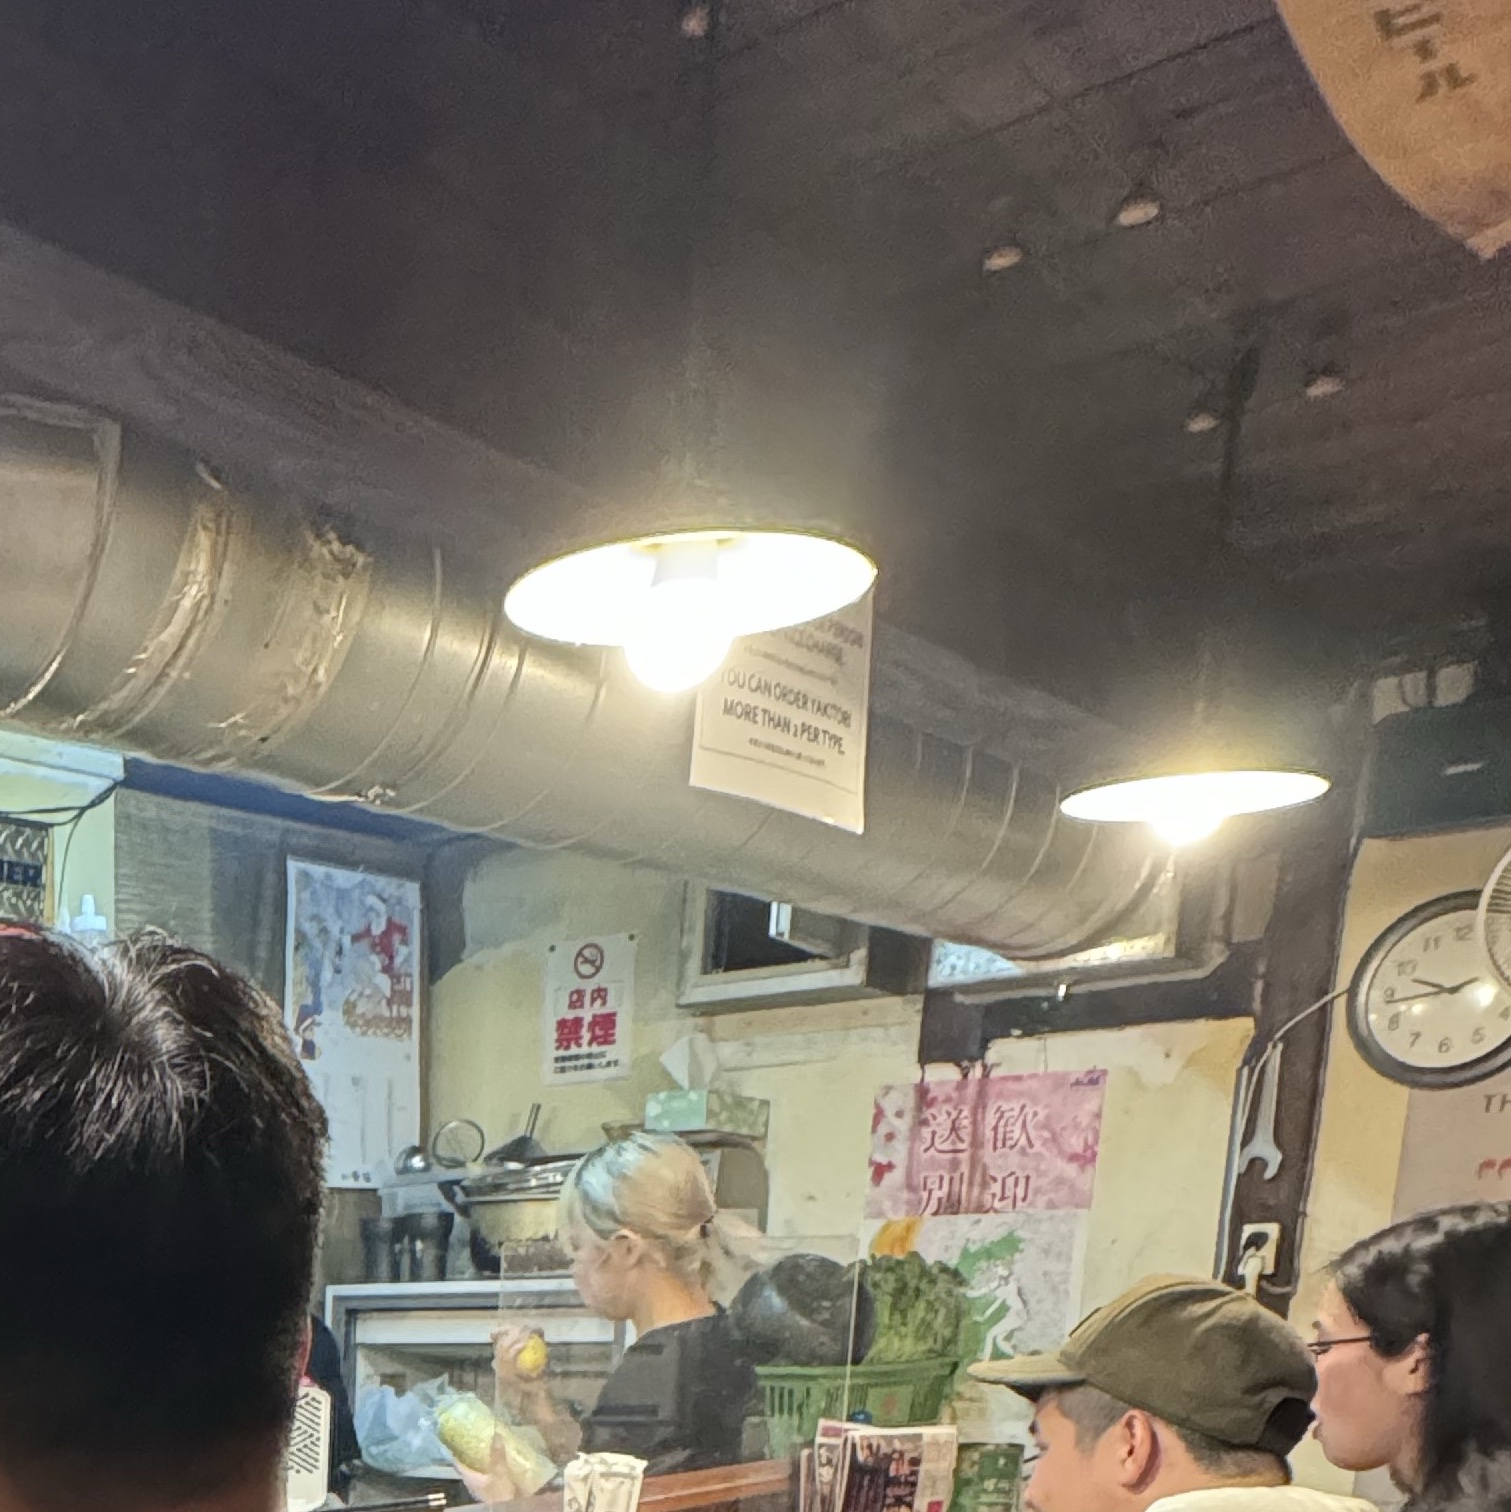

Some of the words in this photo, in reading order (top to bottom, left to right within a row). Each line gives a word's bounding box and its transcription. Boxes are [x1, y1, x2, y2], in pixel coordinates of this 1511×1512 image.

[748, 673, 772, 699] CAN
[773, 682, 809, 711] ORDER
[722, 697, 759, 725] MORE
[760, 708, 792, 735] THAN
[799, 721, 820, 745] PER
[568, 986, 608, 1010] 店内
[554, 1011, 617, 1051] 禁煙
[1409, 1031, 1422, 1048] 7
[1438, 1036, 1453, 1054] 6
[918, 1107, 971, 1216] 送別
[985, 1103, 1039, 1215] 歓迎
